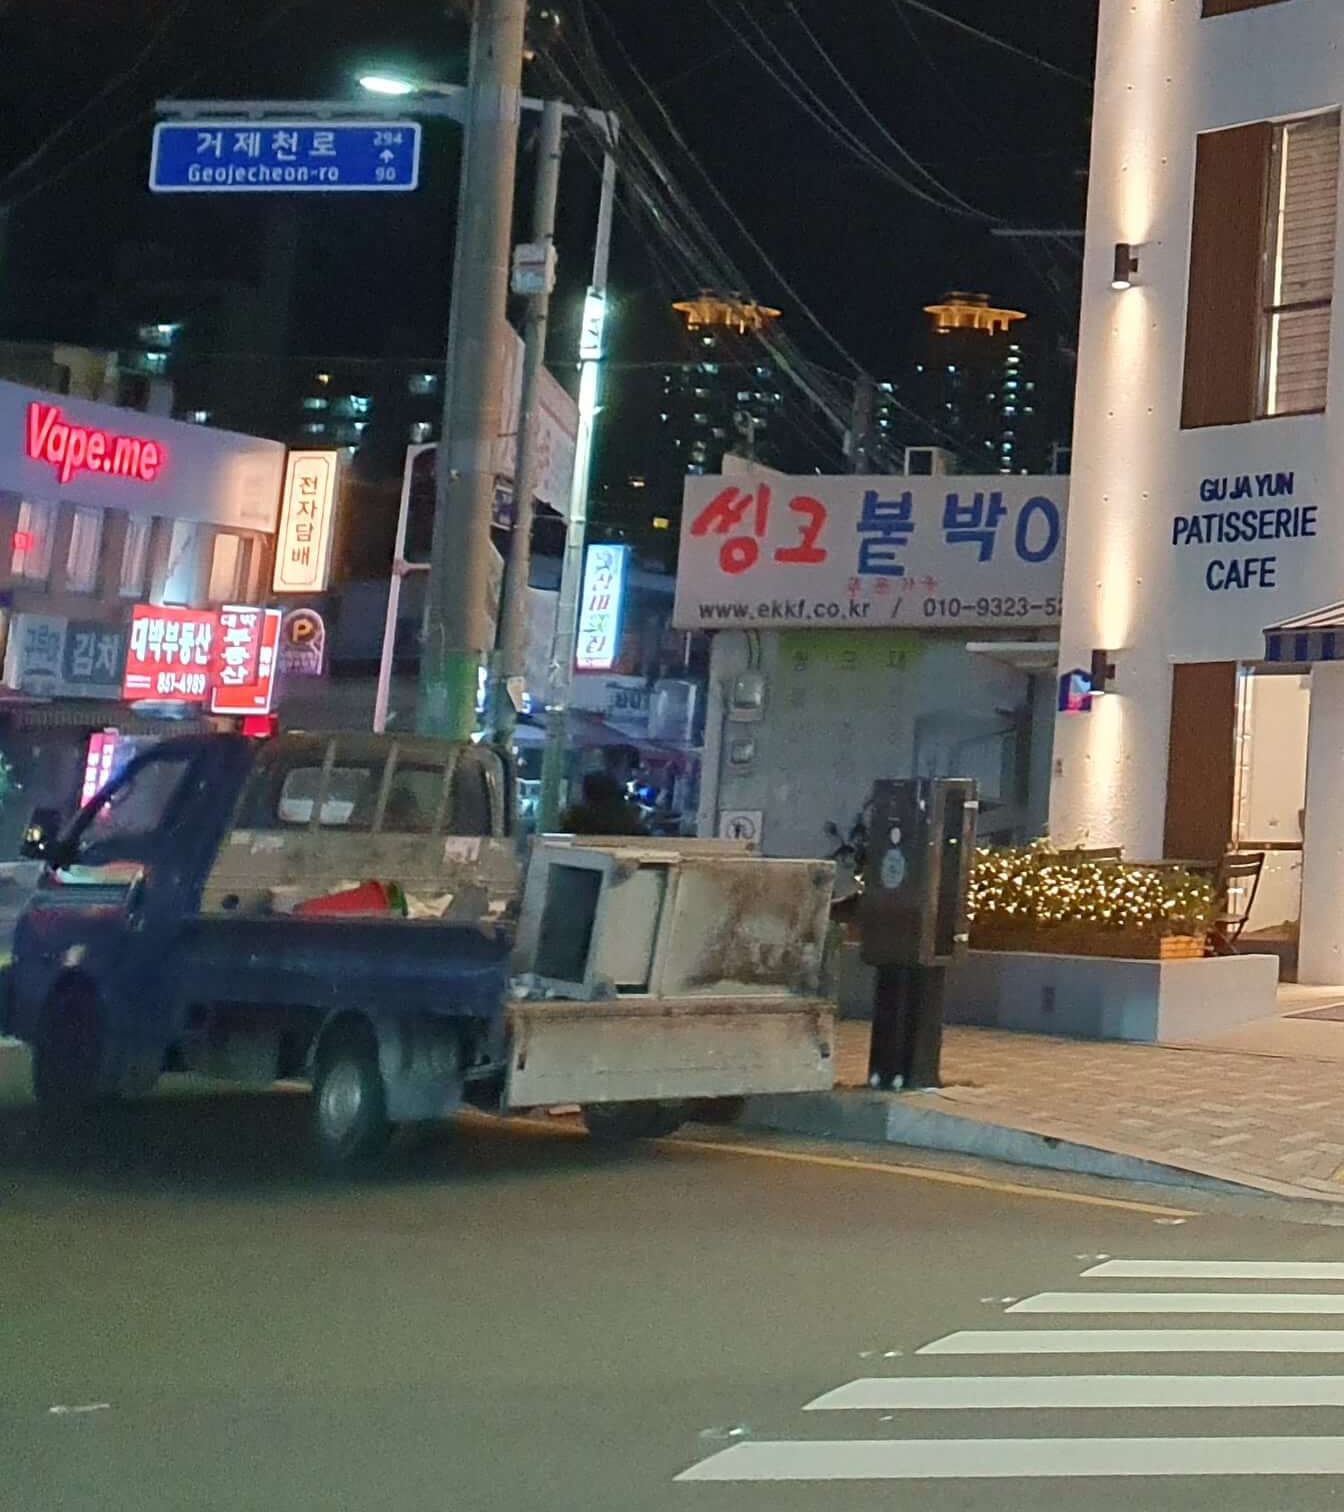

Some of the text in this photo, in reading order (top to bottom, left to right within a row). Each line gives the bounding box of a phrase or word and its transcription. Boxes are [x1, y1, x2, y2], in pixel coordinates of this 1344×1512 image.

[196, 131, 337, 161] 거제천로
[187, 163, 339, 185] Geojecheon-ro
[27, 400, 164, 484] Vape.me
[291, 474, 319, 567] 전자담배
[690, 483, 828, 574] 씽크
[1172, 506, 1318, 545] PATISSERIE
[1206, 557, 1276, 591] CAFE
[131, 618, 211, 664] 대박부동산
